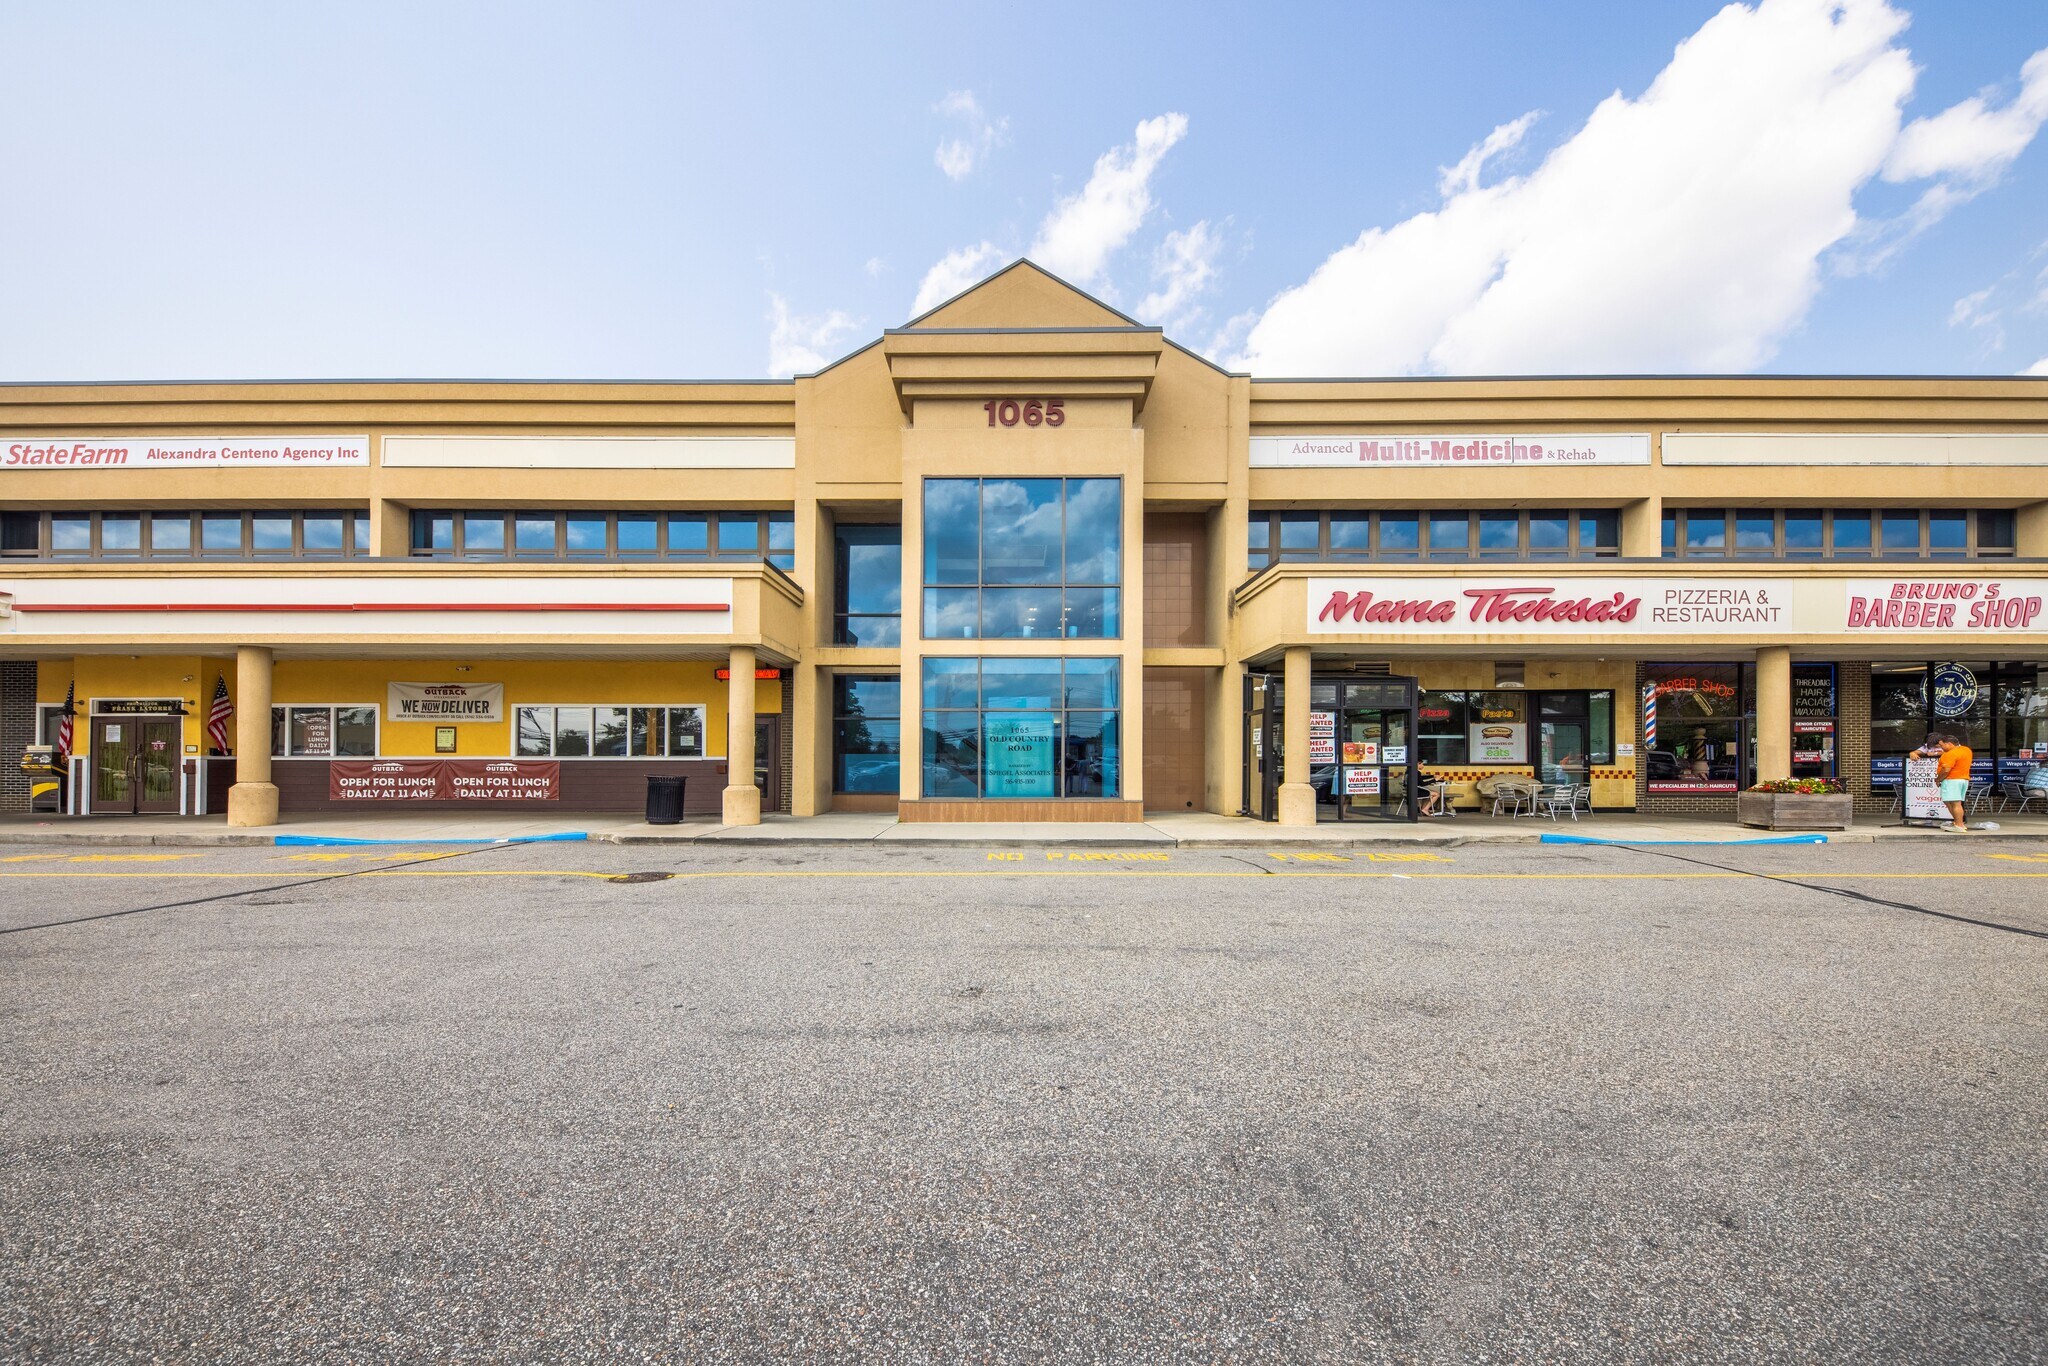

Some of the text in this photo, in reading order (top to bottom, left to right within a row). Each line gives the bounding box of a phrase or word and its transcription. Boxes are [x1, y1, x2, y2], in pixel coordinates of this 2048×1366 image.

[984, 399, 1065, 427] 1065
[147, 448, 217, 460] Alexandra
[221, 447, 279, 459] Centeno
[283, 446, 333, 461] Agency
[338, 446, 359, 458] Inc
[1292, 440, 1596, 461] Advanced Multi-Medicine & Rehab
[1890, 582, 2001, 600] BRUNO'S
[1665, 589, 1769, 605] PIZZERIA &
[1318, 587, 1642, 622] Mama Theresa's
[1652, 607, 1781, 623] RESTAURANT
[1847, 596, 2042, 629] BARBER SHOP
[1796, 679, 1831, 687] THREADING
[424, 688, 467, 696] OUTBACK
[1655, 678, 1735, 698] BARBER SHOP
[1800, 688, 1824, 697] HAIR
[402, 700, 490, 713] WE NOW DELIVER
[1420, 709, 1449, 718] Pizza
[1482, 709, 1514, 718] Pasta
[1795, 708, 1830, 716] WAXING
[1009, 735, 1050, 743] COUNTRY
[1486, 749, 1510, 757] eats
[339, 777, 436, 786] OPEN FOR LUNCH
[453, 777, 549, 787] OPEN FOR LUNCH
[347, 789, 429, 798] DAILY AT 11 AM
[460, 789, 542, 798] DAILY AT 11 AM
[987, 852, 1024, 861] NO
[1046, 852, 1169, 861] PARKING
